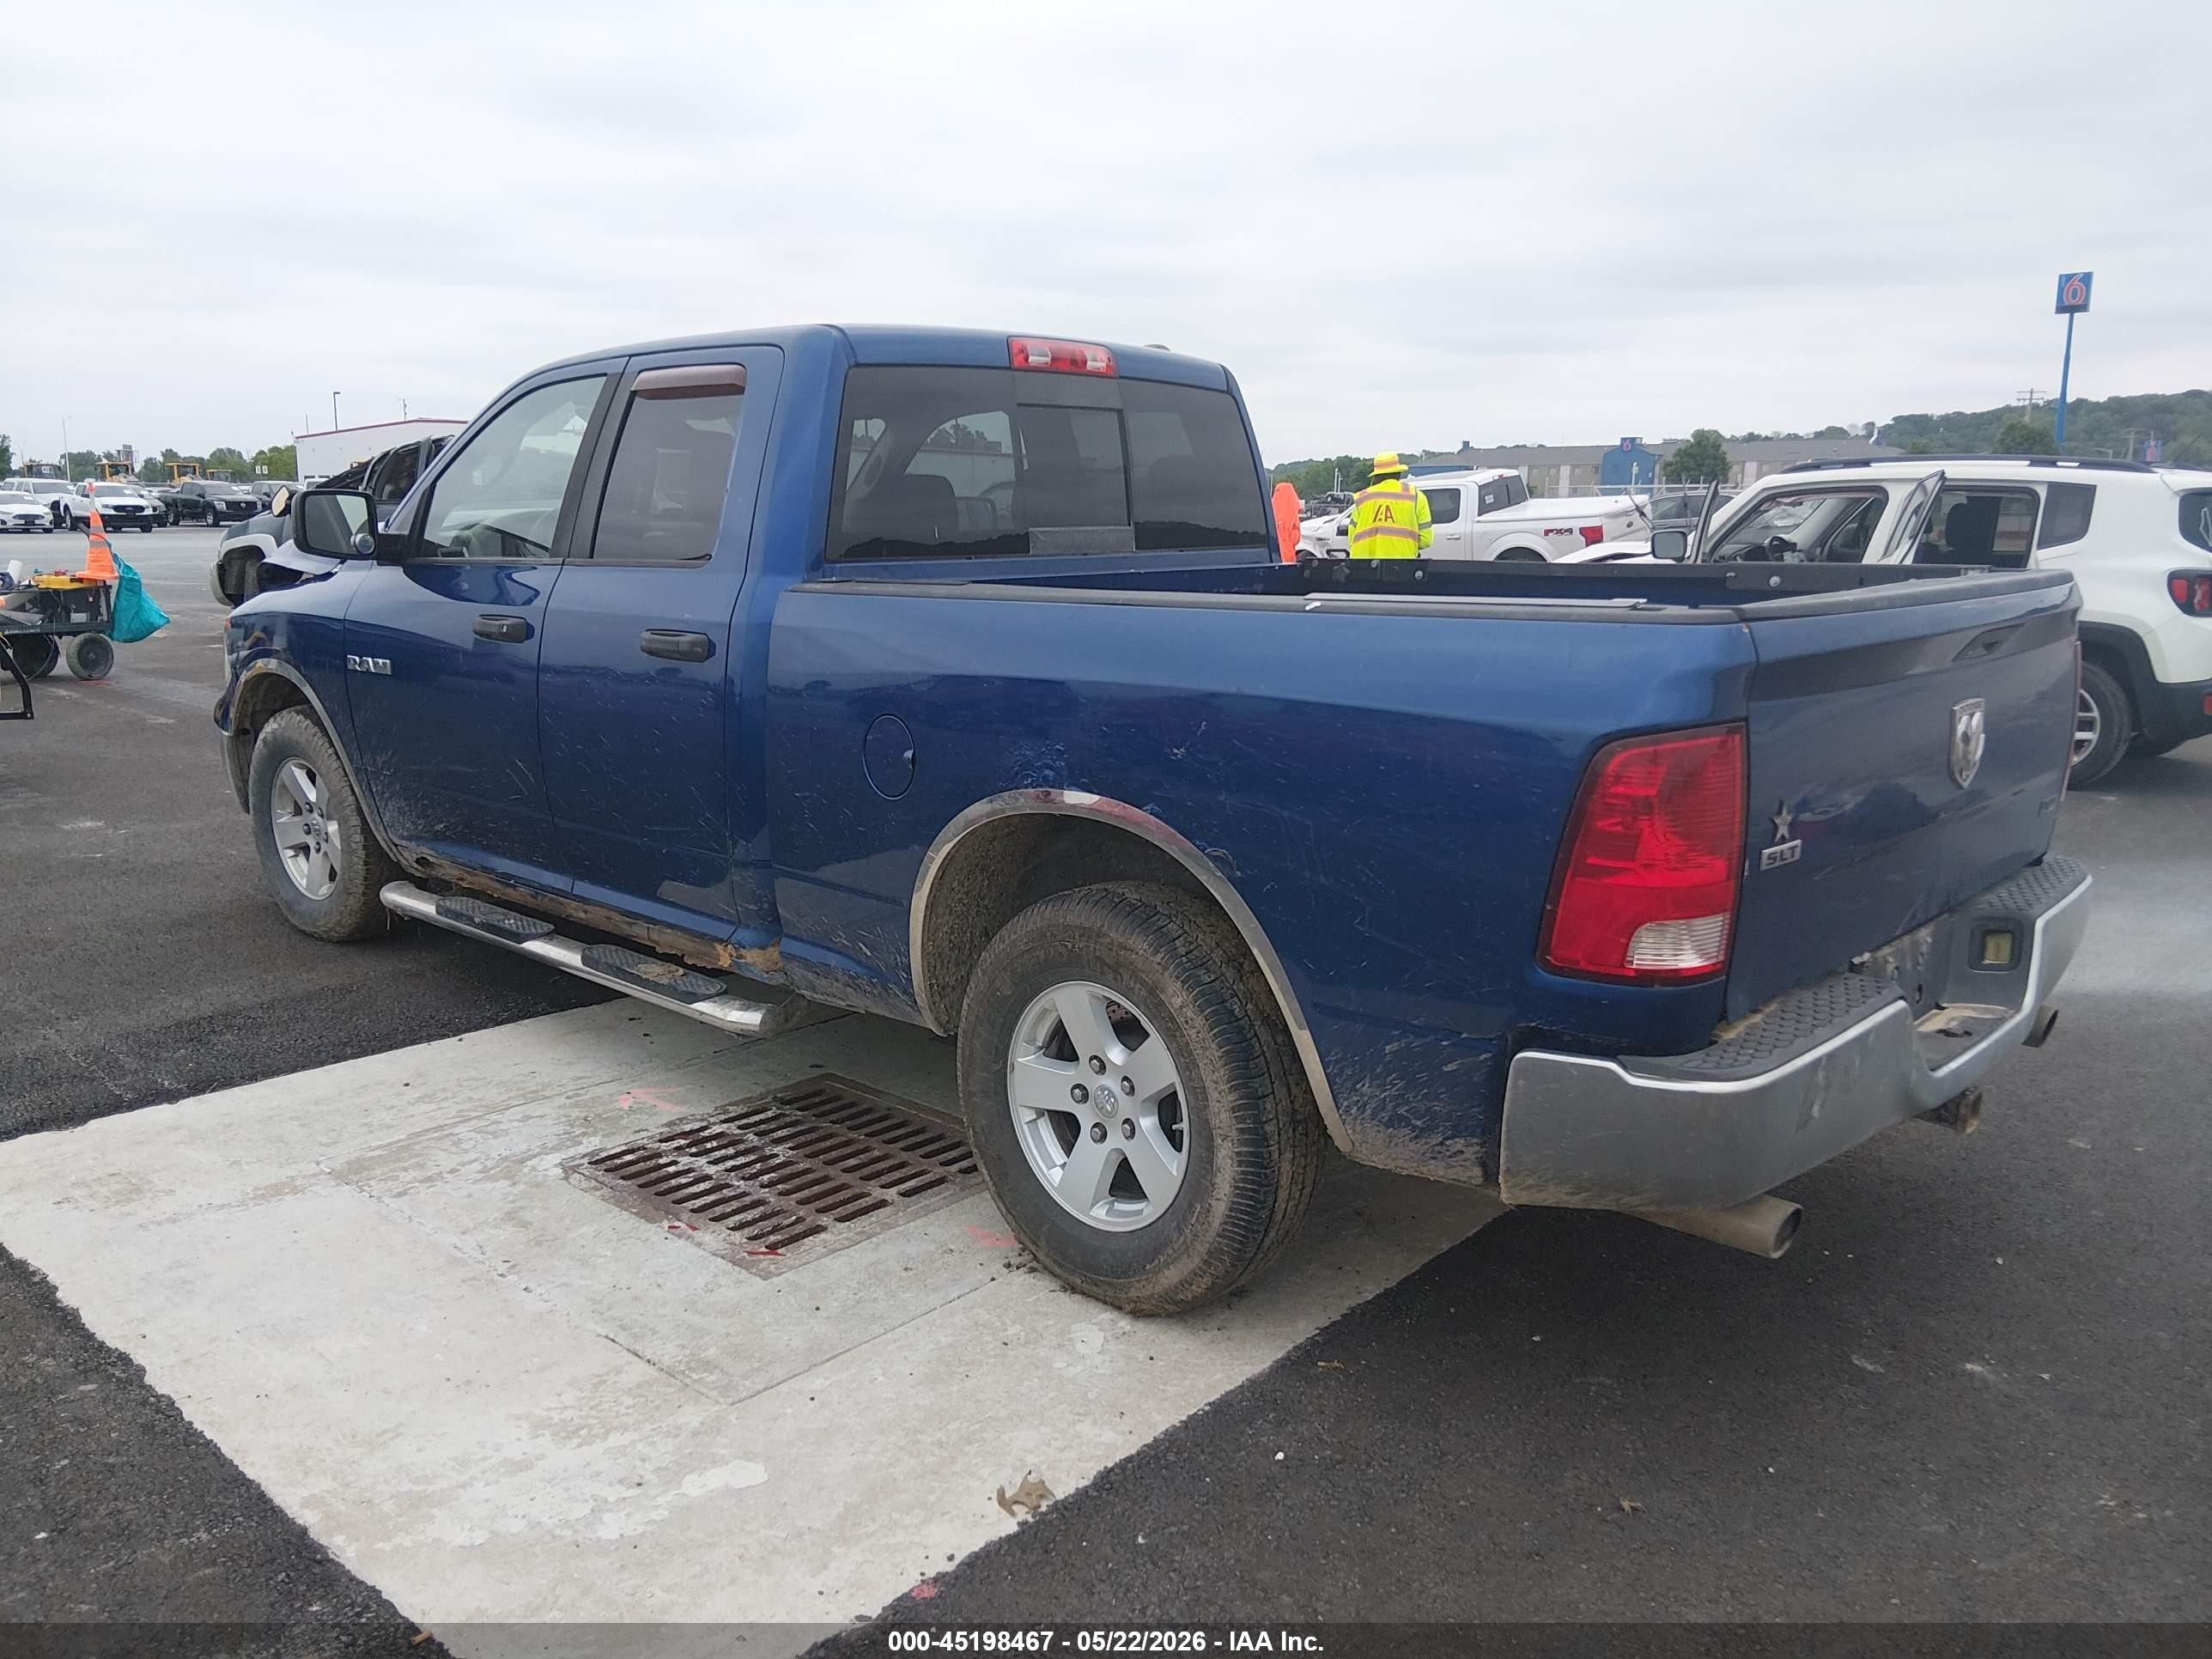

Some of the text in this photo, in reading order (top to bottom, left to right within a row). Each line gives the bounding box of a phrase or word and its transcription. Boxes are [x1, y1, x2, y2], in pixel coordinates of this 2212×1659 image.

[2063, 272, 2087, 307] 6
[346, 654, 392, 676] RAM
[1765, 844, 1800, 866] SLT
